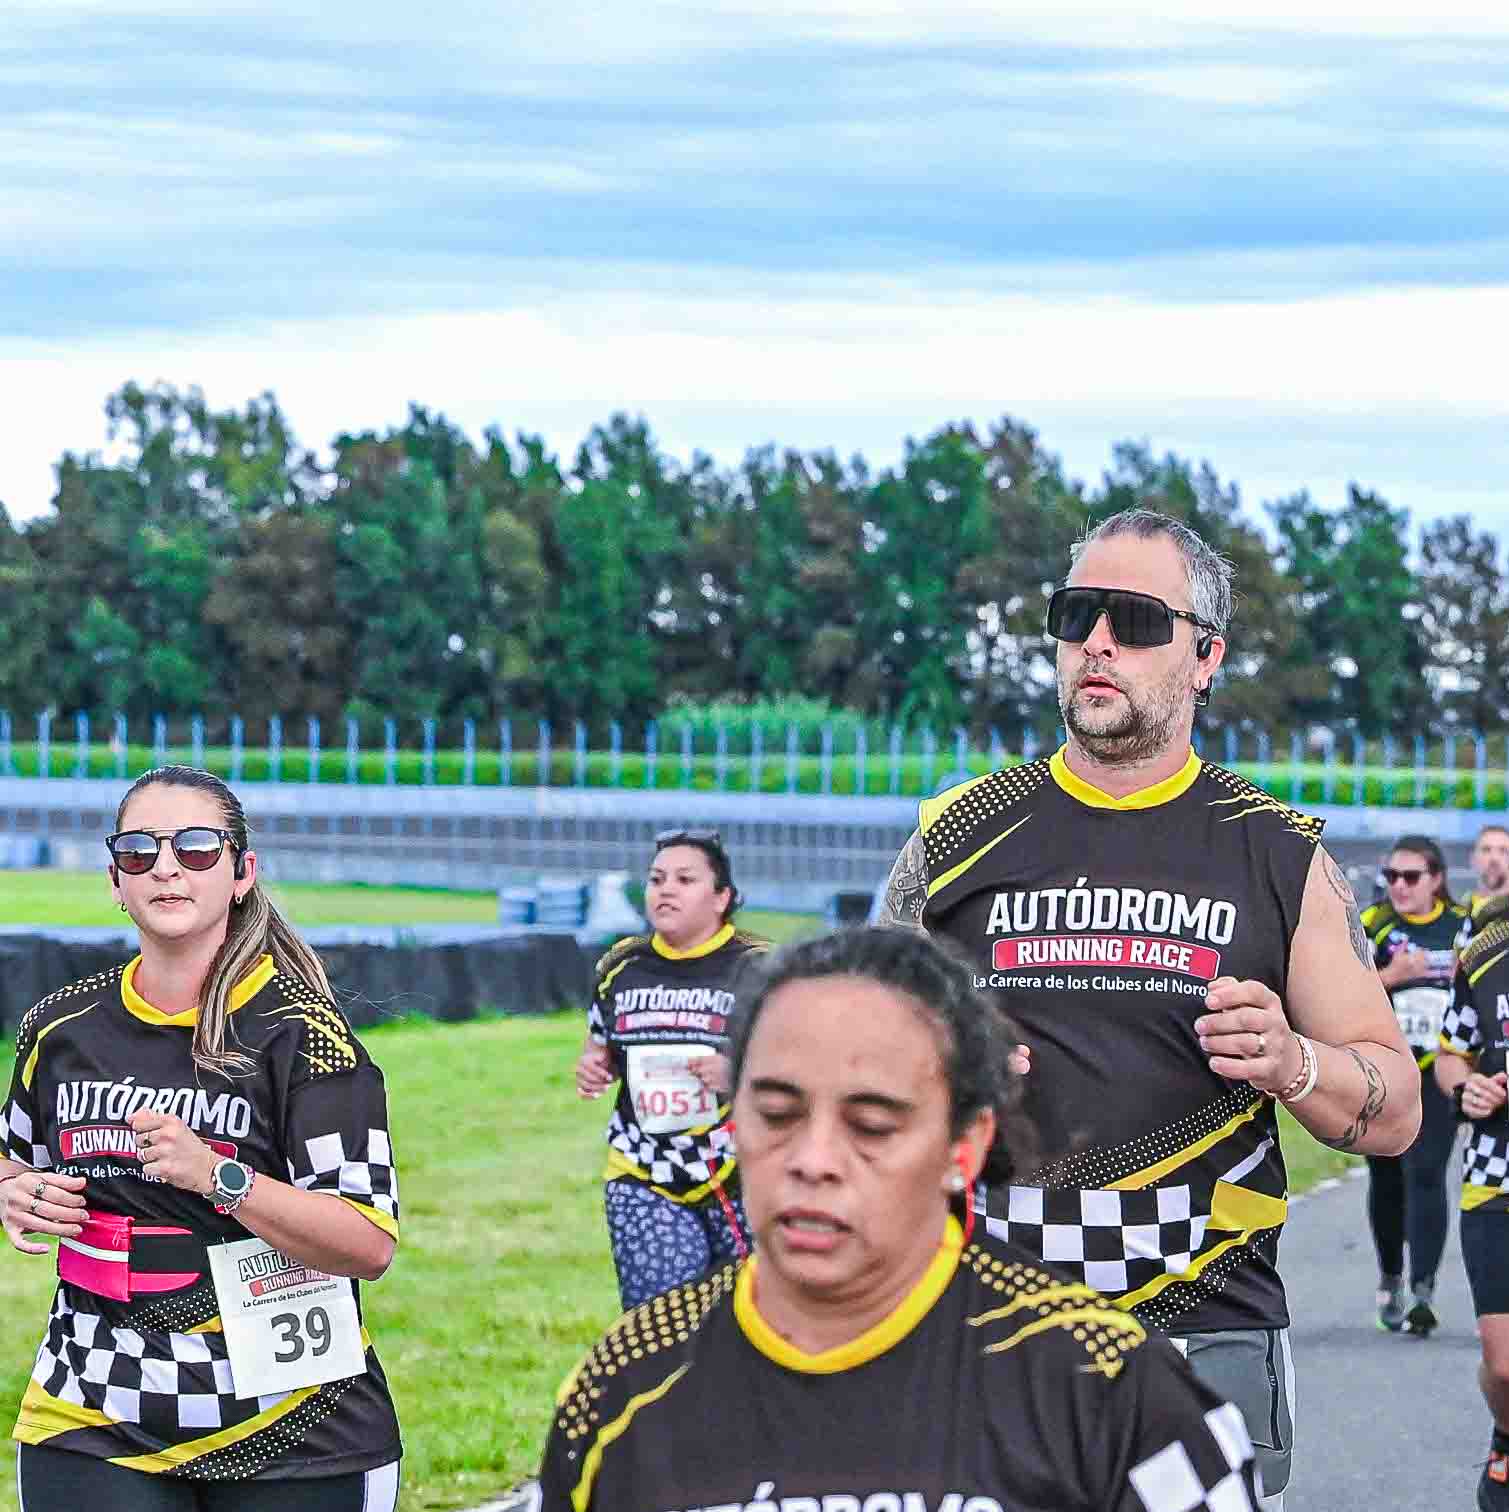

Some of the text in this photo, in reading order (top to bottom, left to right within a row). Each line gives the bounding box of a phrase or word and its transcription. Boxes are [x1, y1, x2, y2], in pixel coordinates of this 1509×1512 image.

[985, 876, 1238, 946] AUTÓDROMO
[1017, 939, 1193, 971] RUNNING RACE
[614, 984, 736, 1016] AUTÓDROMO
[972, 973, 1208, 997] La Carrera de los Clubes del Noro
[57, 1076, 251, 1139] AUTÓDROMO
[636, 1087, 712, 1117] 4051
[72, 1129, 137, 1154] RUNNIN
[261, 1271, 304, 1292] RUNNING
[243, 1300, 251, 1308] La
[252, 1297, 277, 1307] Carrera
[278, 1293, 286, 1302] de
[271, 1306, 332, 1363] 39
